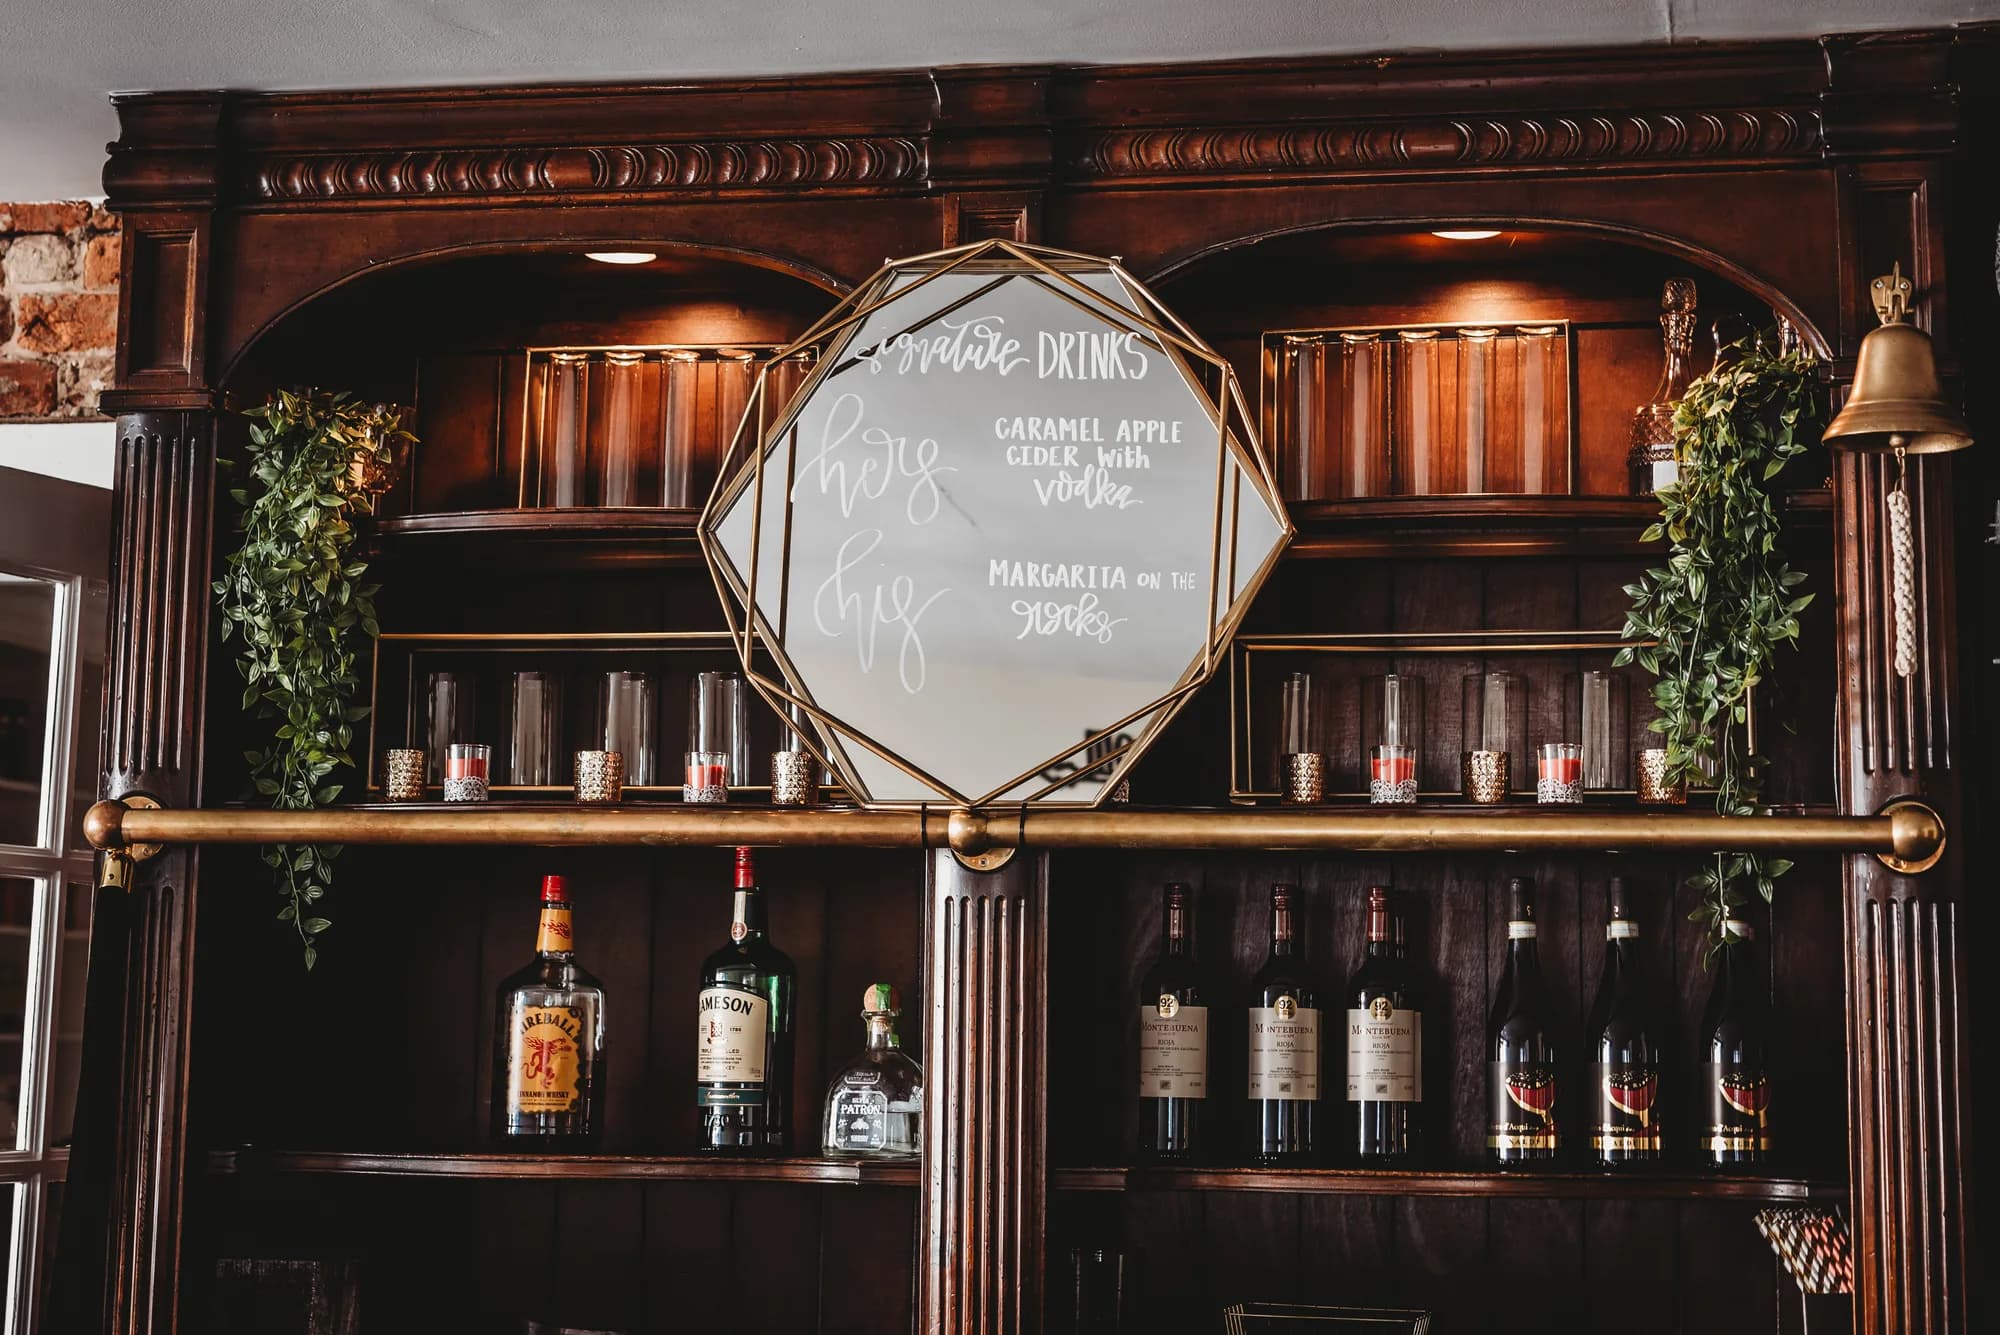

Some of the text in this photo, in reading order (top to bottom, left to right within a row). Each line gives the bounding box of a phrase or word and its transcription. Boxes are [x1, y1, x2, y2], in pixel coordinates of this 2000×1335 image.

[854, 316, 1148, 380] signature DRINKS
[995, 416, 1183, 444] CARAMEL APPLE
[790, 393, 959, 526] hers
[1006, 445, 1080, 468] CIDER
[1033, 463, 1145, 510] vodka
[989, 559, 1127, 590] MARGARITA
[1171, 572, 1196, 591] THE
[814, 528, 952, 694] his
[1011, 592, 1129, 644] rocks
[1160, 998, 1174, 1008] 92
[1279, 999, 1293, 1009] 92
[1375, 1001, 1388, 1011] 92
[521, 1012, 575, 1036] IREBALL
[1351, 1024, 1411, 1036] MNTEBUENA
